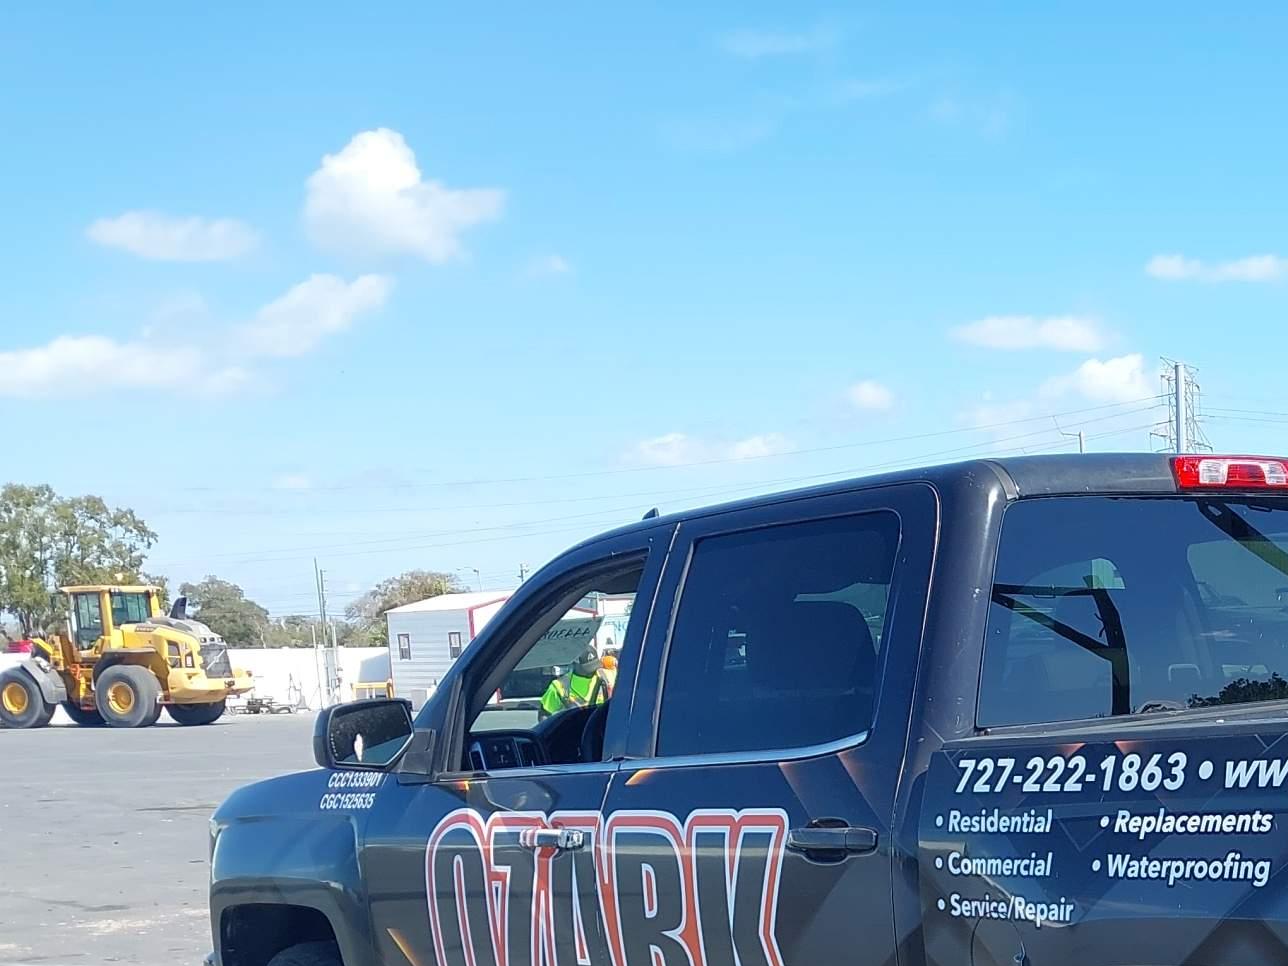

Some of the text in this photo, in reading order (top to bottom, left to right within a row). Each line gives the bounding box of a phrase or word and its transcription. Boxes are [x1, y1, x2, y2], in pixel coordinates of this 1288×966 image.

[327, 771, 384, 789] CCC1333901
[954, 751, 1188, 794] 727-222-1863
[319, 792, 377, 809] CGC1525635
[947, 808, 1053, 834] Residential
[1112, 809, 1274, 840] Replacements
[947, 851, 1053, 877] Commercial
[1105, 852, 1272, 888] Waterproofing
[949, 893, 1075, 928] Service/Repair
